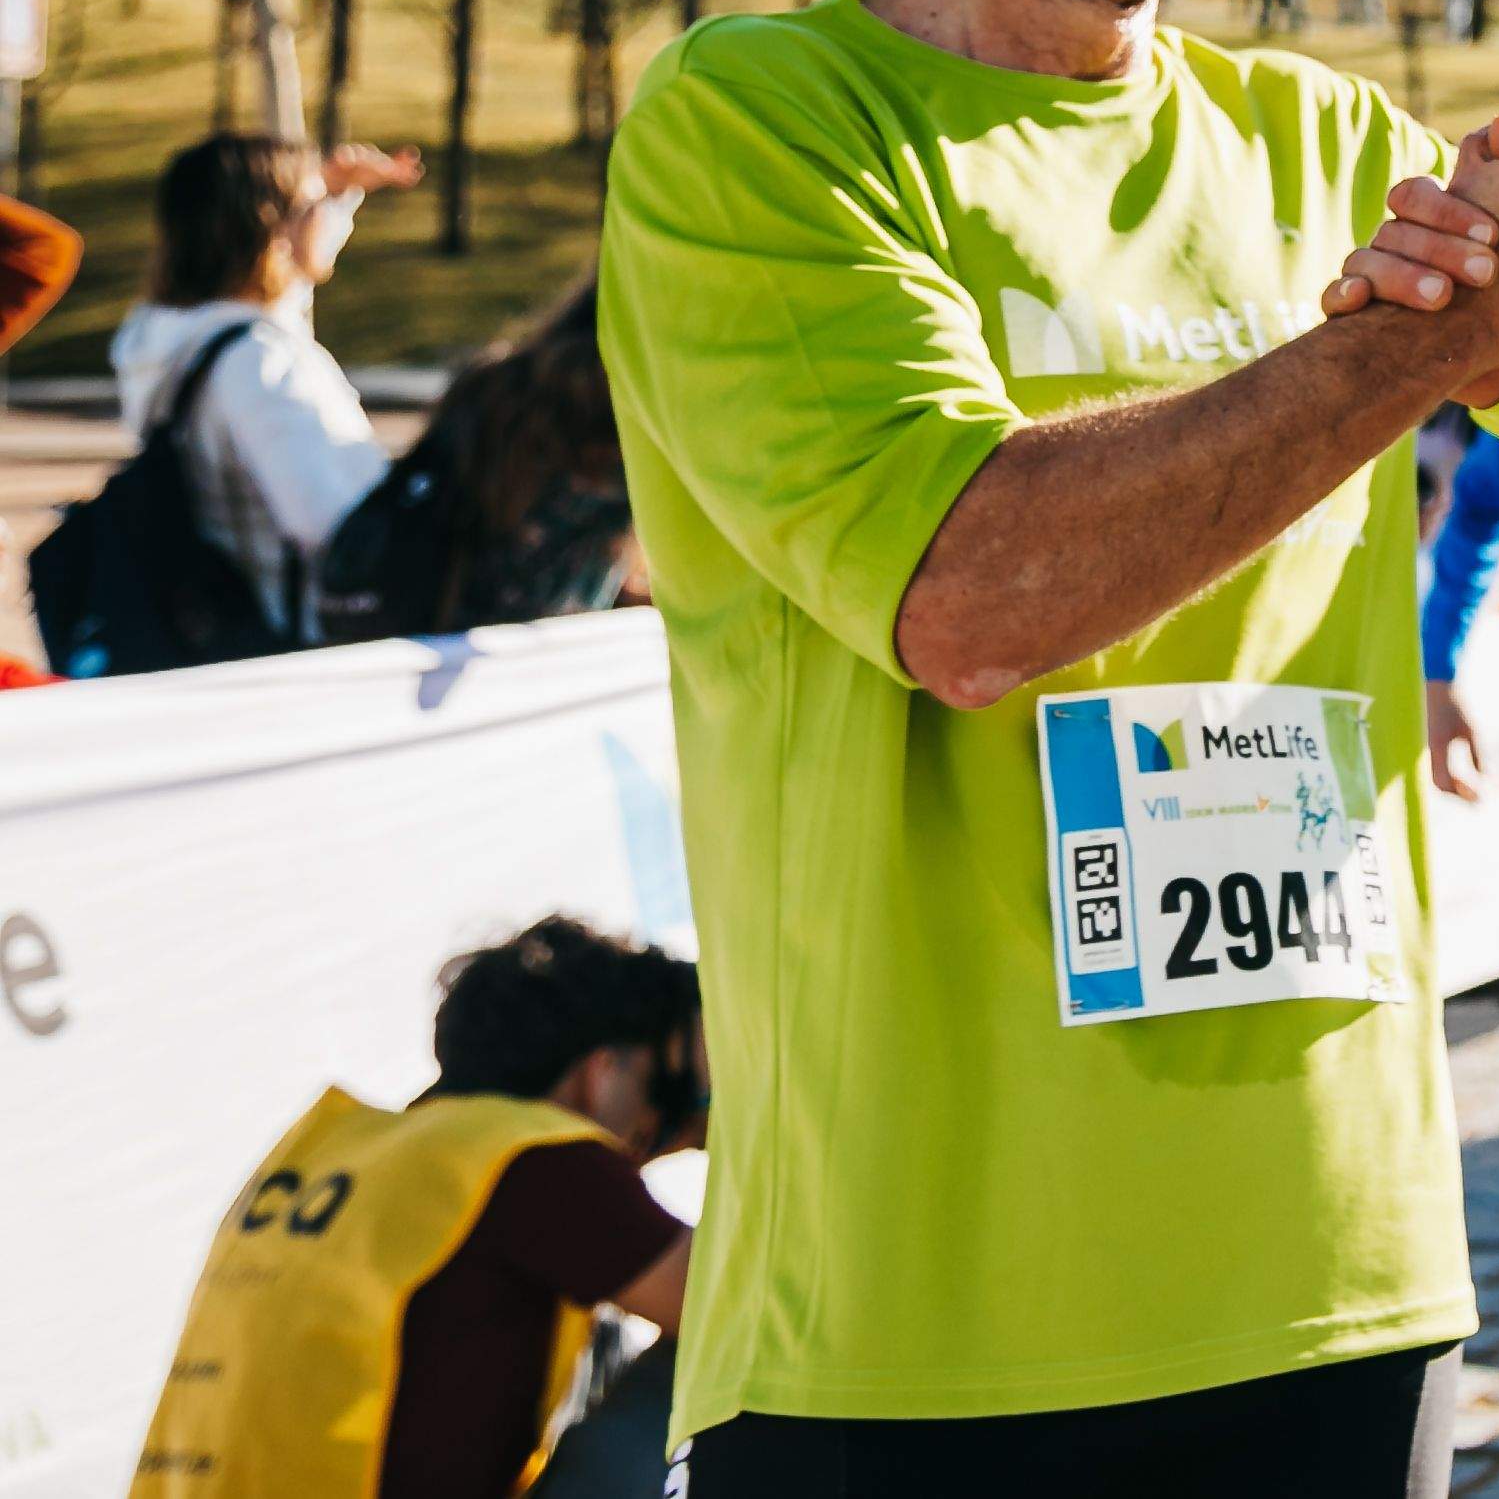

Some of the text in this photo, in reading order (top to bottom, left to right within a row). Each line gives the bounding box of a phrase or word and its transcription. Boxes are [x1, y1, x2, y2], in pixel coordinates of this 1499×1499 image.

[1202, 724, 1321, 759] MetLife
[1142, 796, 1181, 821] VIII
[1160, 871, 1352, 980] 2944
